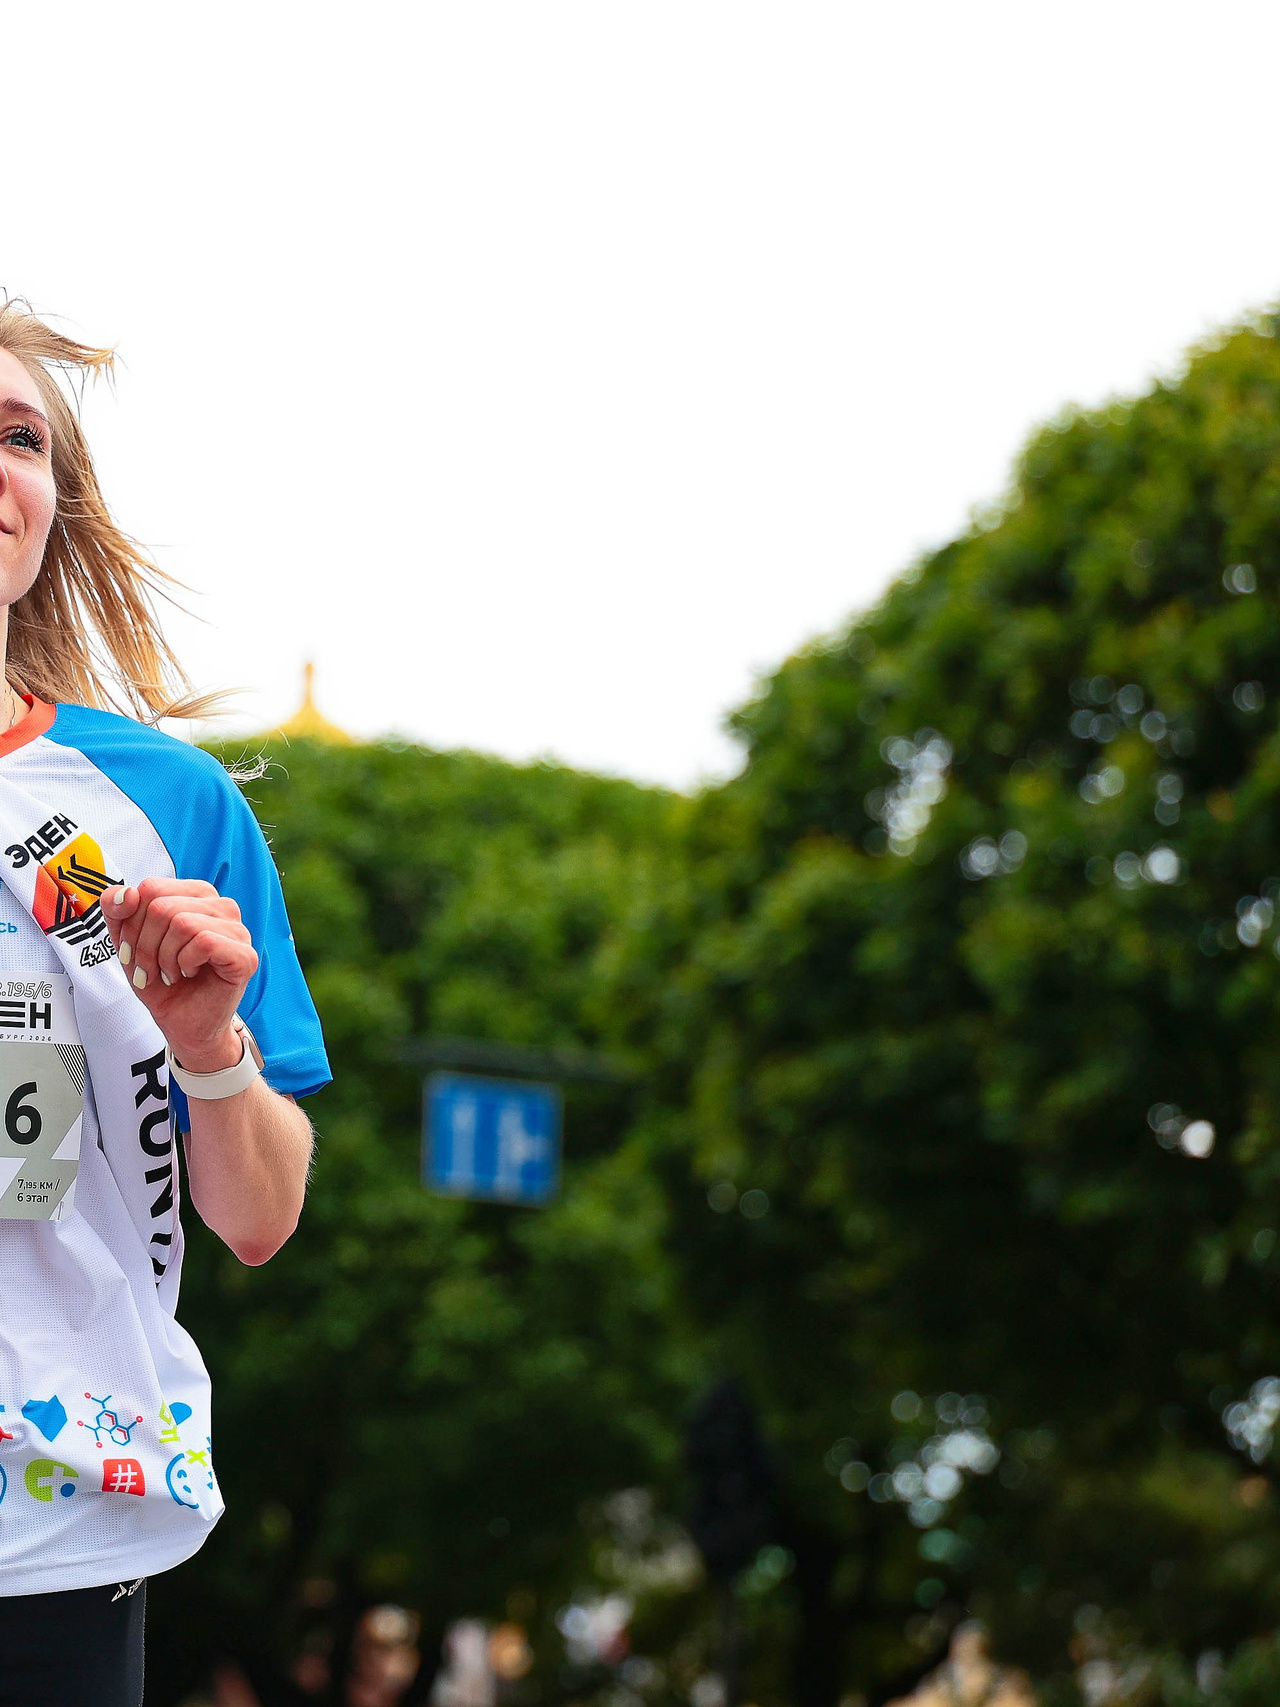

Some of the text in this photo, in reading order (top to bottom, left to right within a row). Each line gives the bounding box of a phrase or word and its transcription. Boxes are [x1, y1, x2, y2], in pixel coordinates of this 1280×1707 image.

[17, 1178, 38, 1190] 7,195
[17, 1192, 49, 1203] 6 этап
